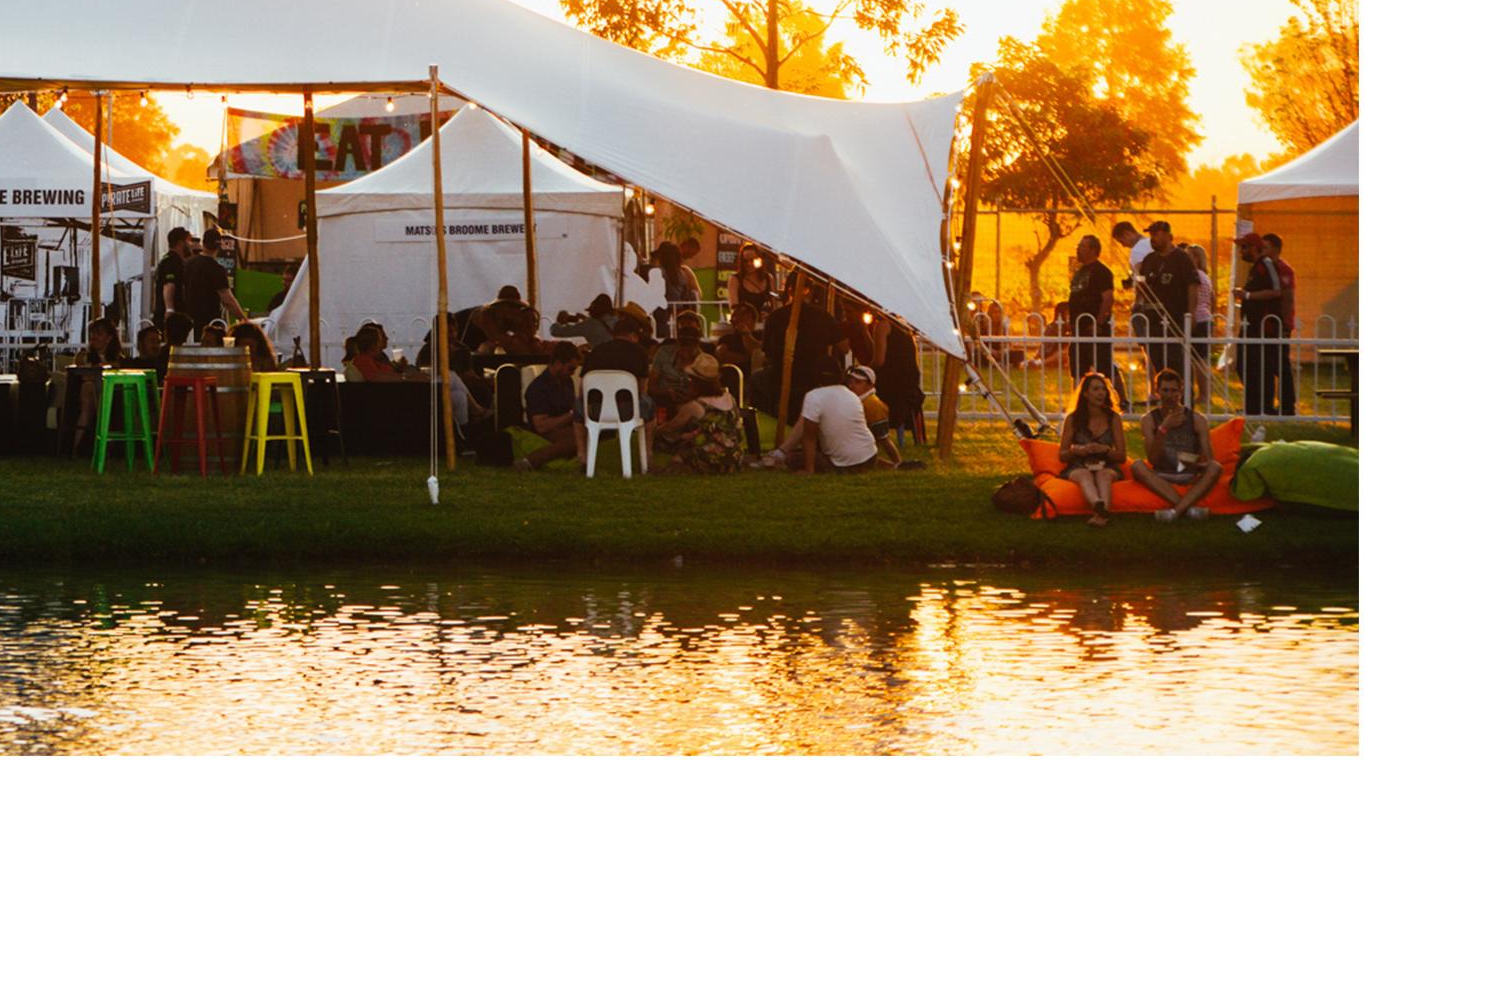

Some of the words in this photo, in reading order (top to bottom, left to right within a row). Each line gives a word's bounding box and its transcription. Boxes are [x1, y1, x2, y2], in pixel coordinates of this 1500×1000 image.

[297, 122, 392, 172] EAT
[12, 189, 85, 205] BREWING
[449, 224, 489, 235] BROOME
